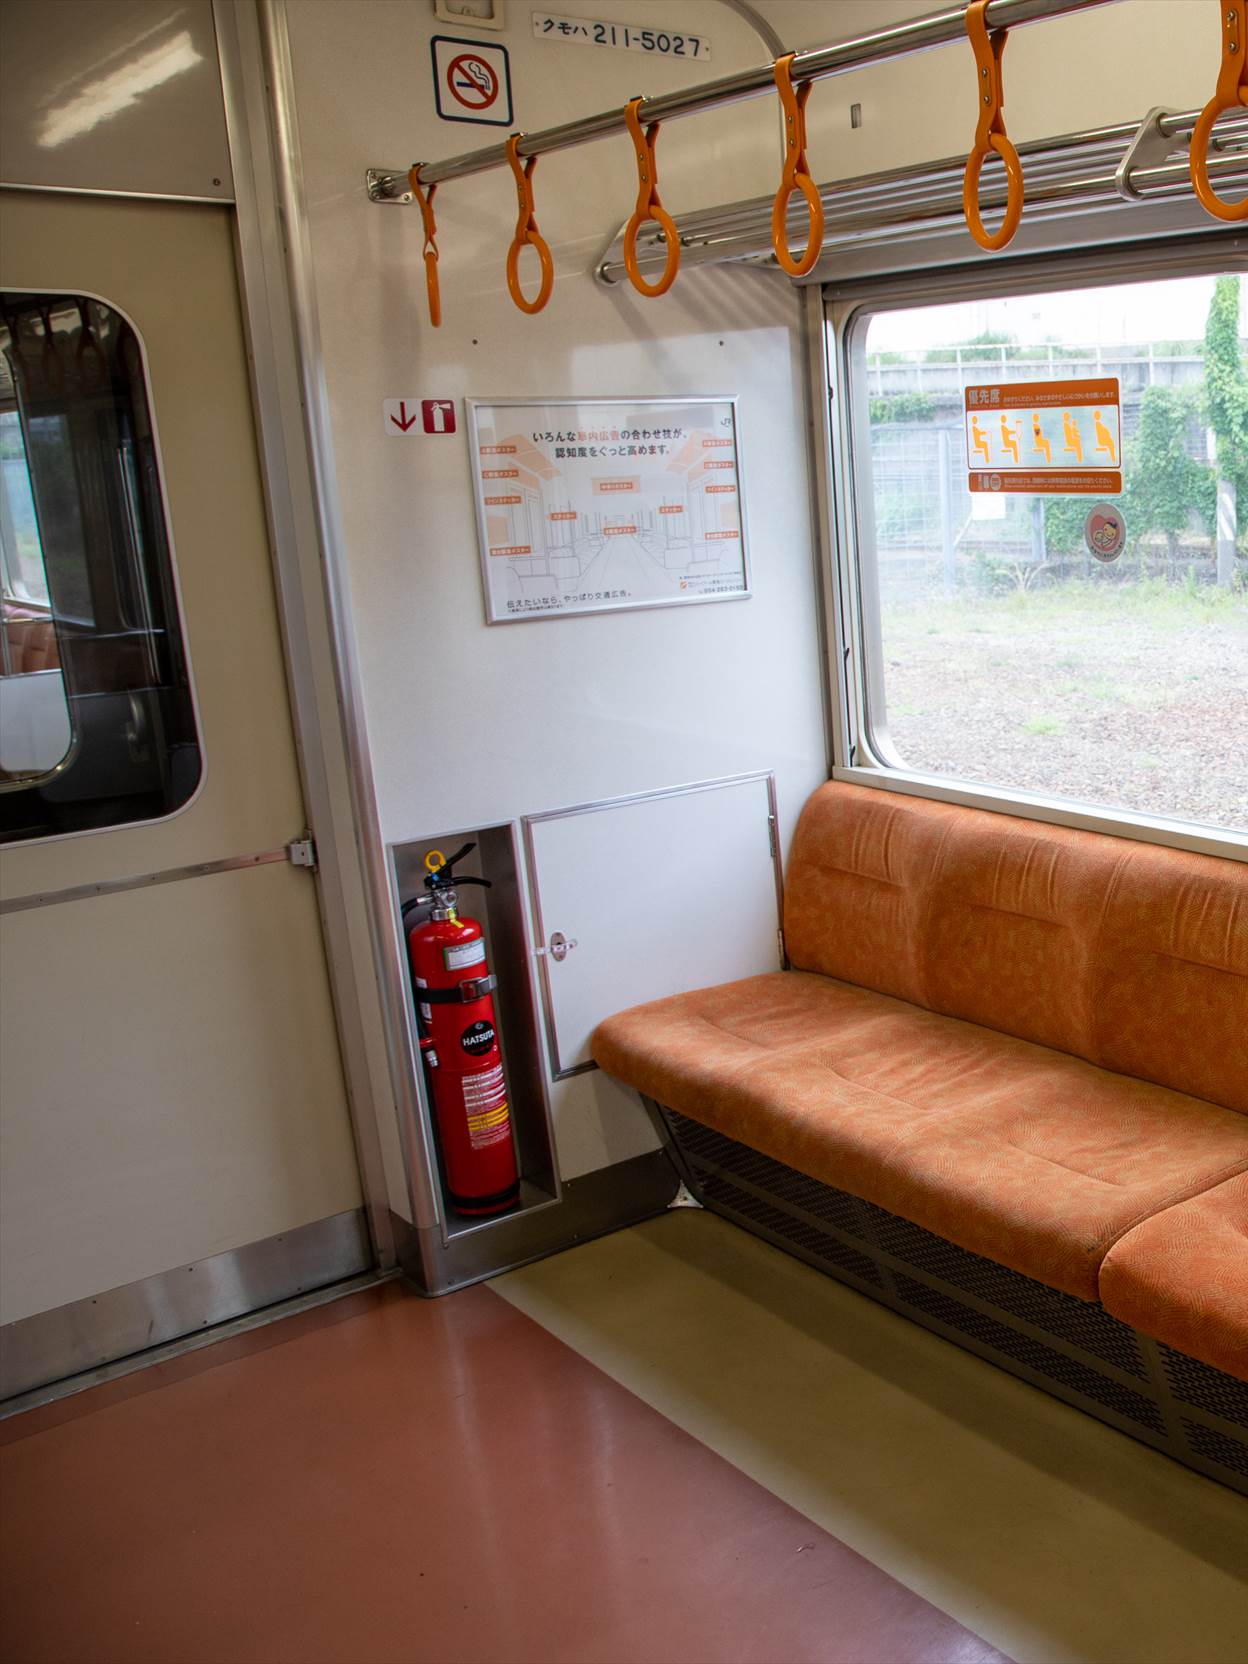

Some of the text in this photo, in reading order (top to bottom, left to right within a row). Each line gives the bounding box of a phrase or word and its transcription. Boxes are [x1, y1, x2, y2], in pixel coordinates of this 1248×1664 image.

[543, 18, 700, 57] クモハ 211-5027
[554, 444, 671, 458] 認知度をぐっと高めます。
[462, 1029, 495, 1046] HATSUTA
